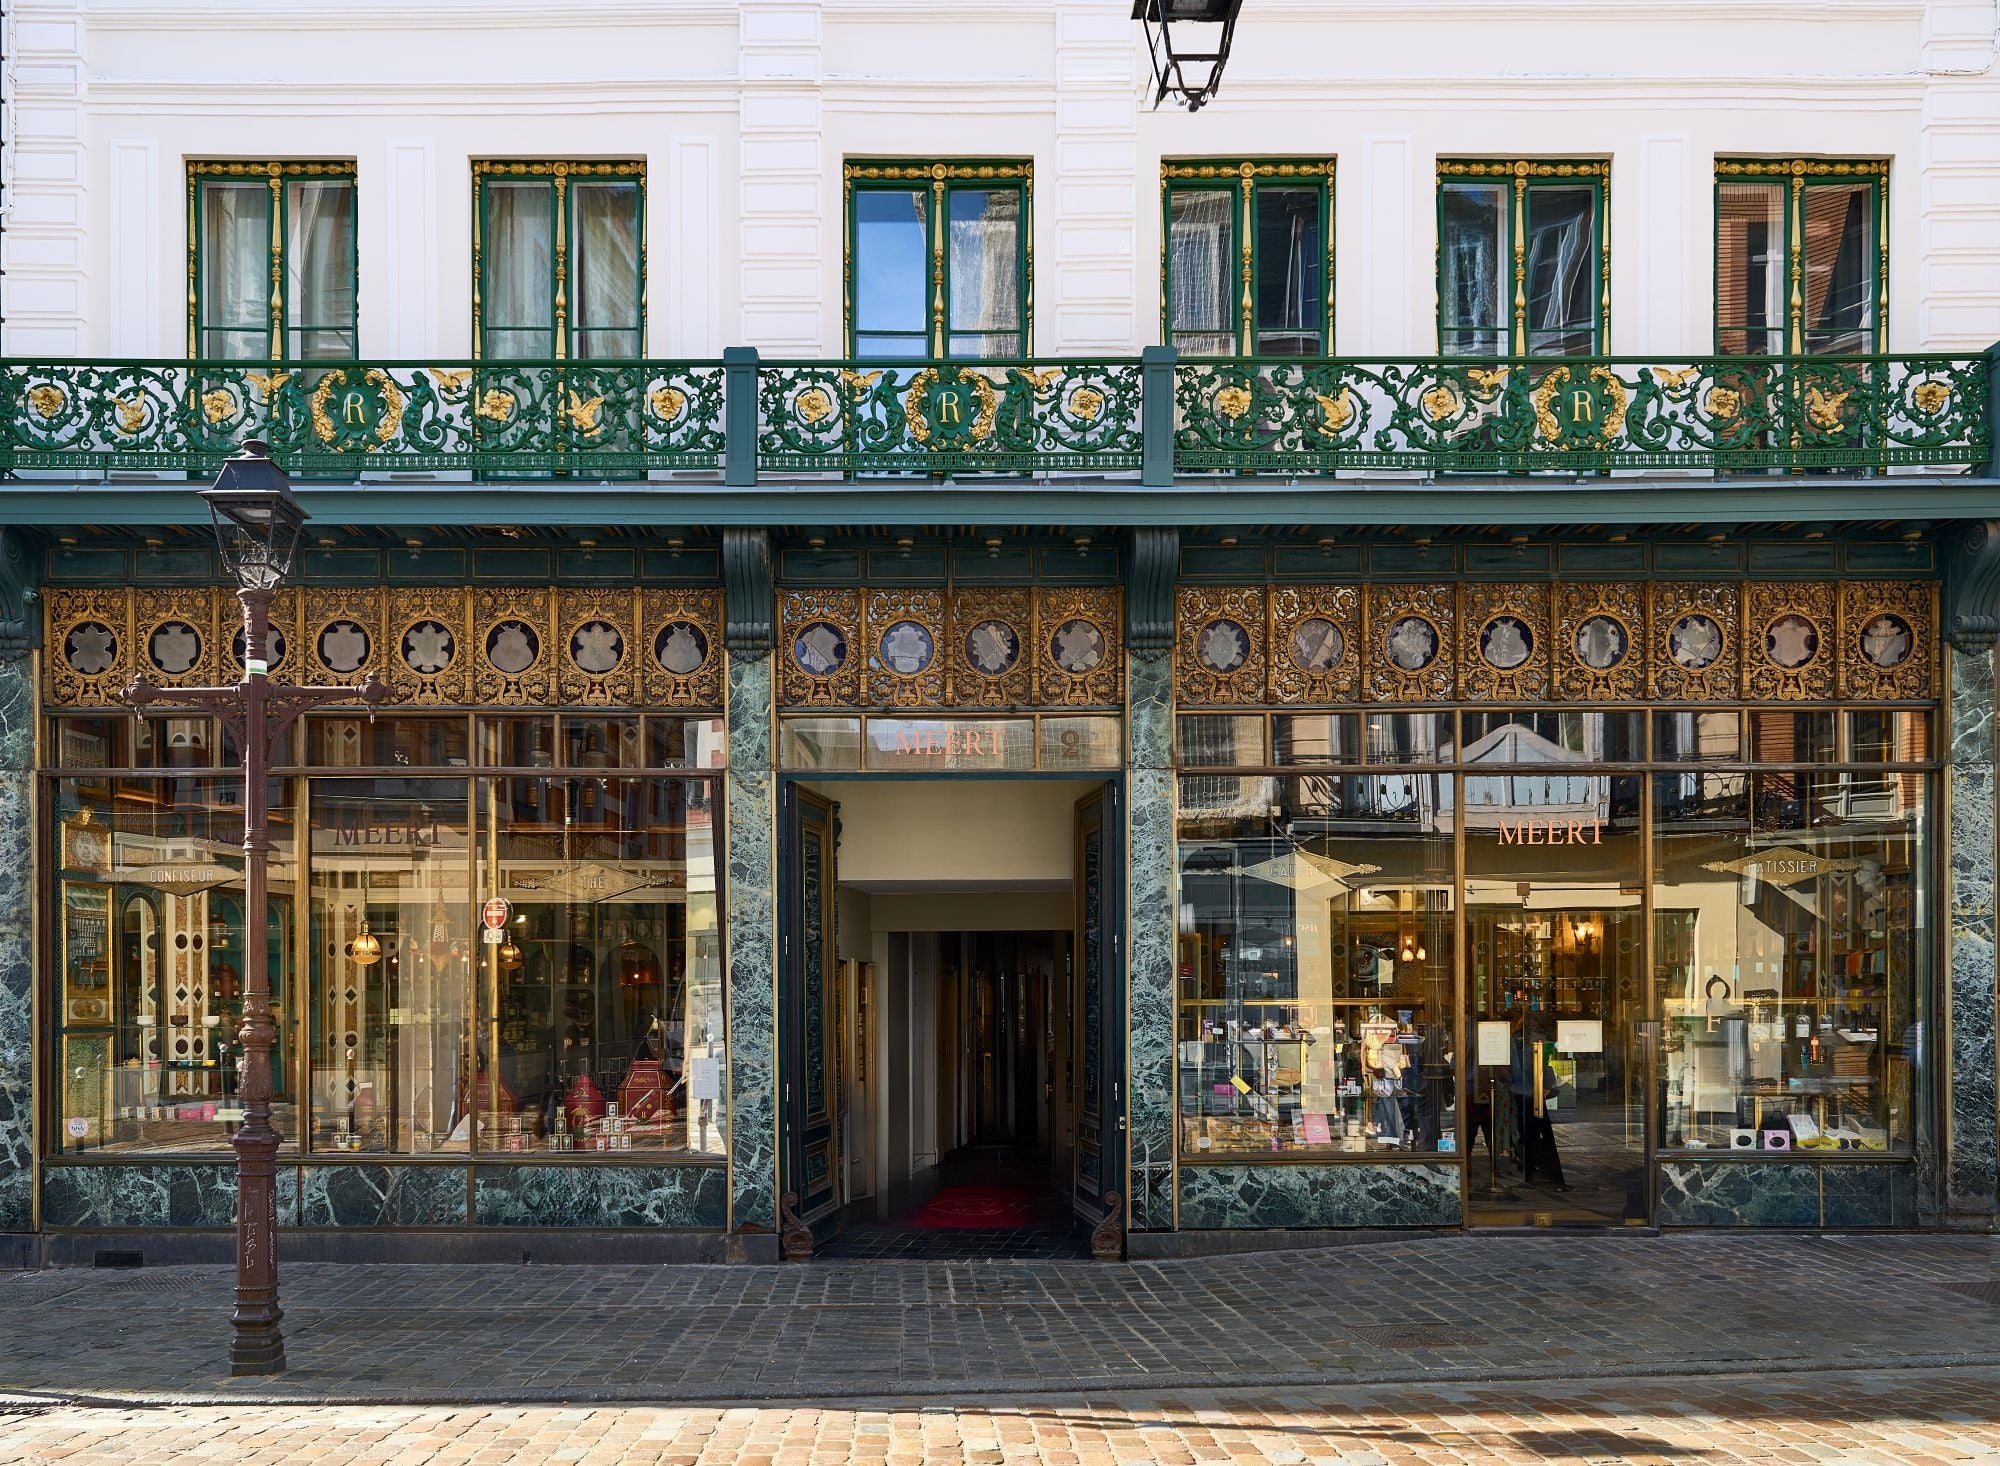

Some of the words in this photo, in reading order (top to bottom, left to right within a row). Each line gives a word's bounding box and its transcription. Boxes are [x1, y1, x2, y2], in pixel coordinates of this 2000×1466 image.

[345, 392, 365, 424] R
[940, 391, 960, 423] R
[1572, 390, 1592, 422] R
[895, 729, 1006, 756] MEERT
[1060, 729, 1080, 757] 2
[333, 817, 446, 846] MEERT
[1497, 818, 1608, 846] MEERT
[150, 869, 214, 883] CONFISEUR
